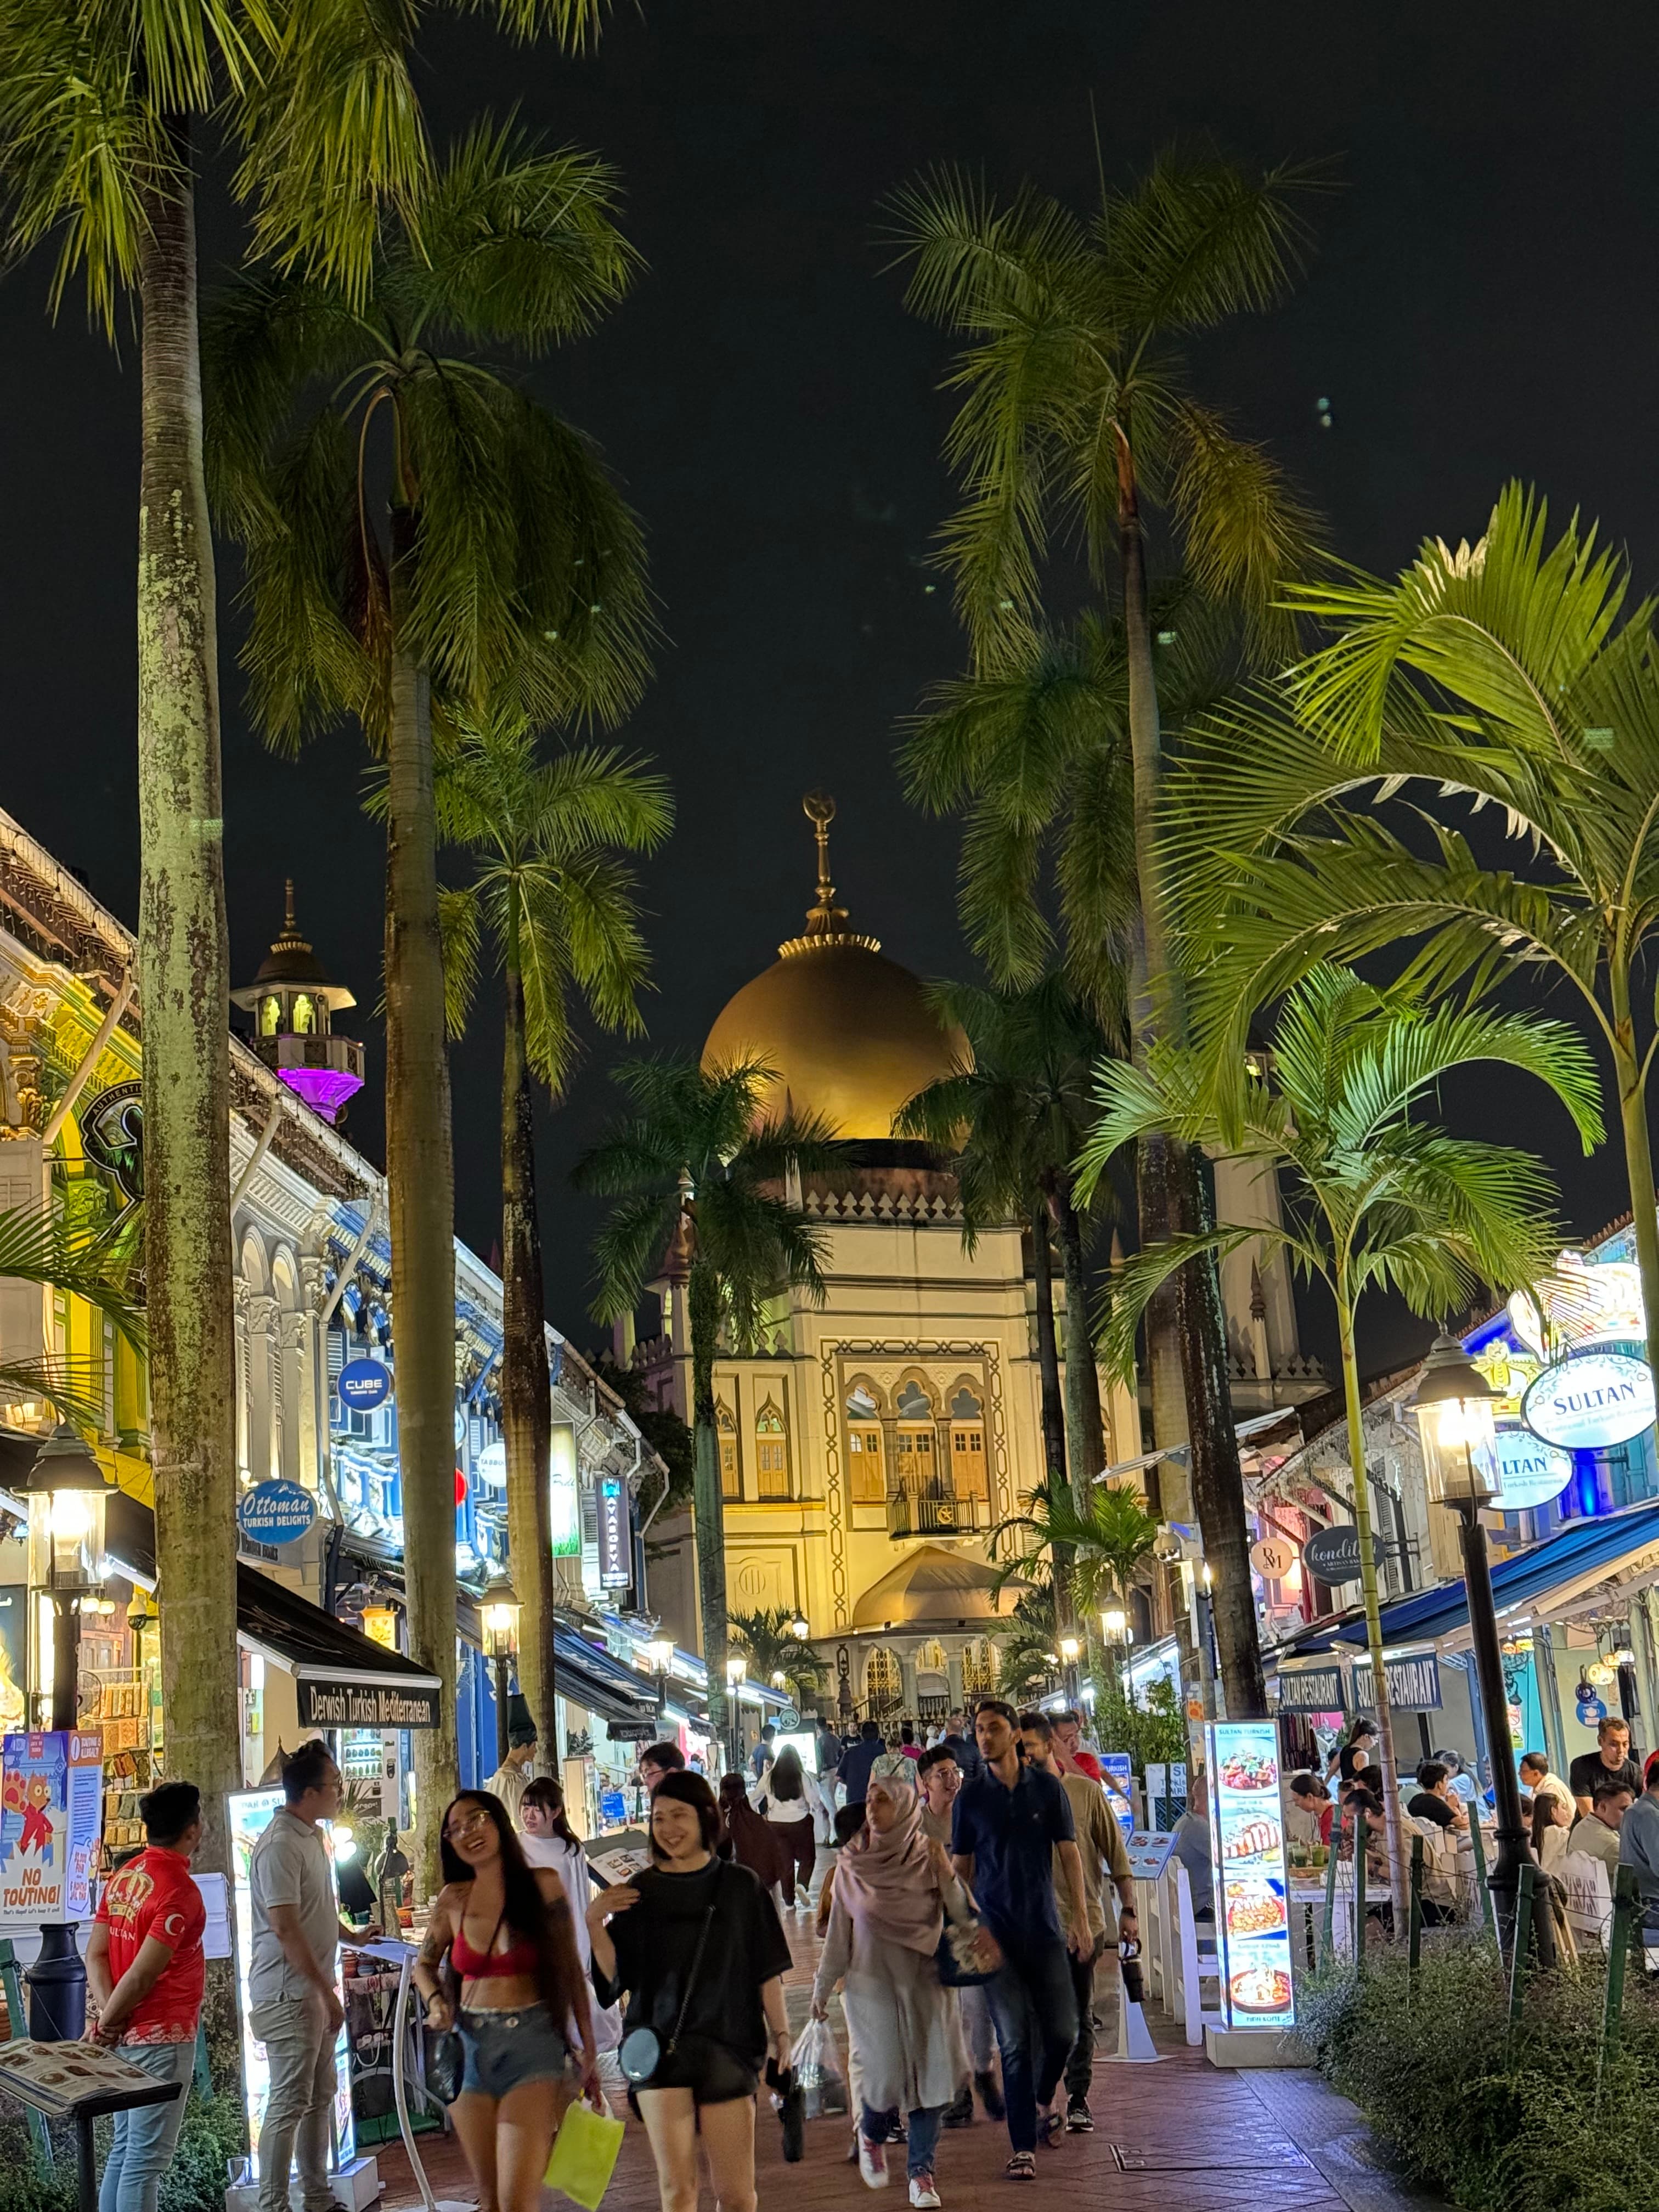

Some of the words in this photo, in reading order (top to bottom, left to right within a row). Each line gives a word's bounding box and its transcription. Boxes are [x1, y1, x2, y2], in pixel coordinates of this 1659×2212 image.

[346, 1379, 382, 1390] CUBE
[1553, 1382, 1636, 1415] SULTAN
[1502, 1457, 1548, 1475] LTAN
[244, 1493, 310, 1516] Ottoman
[243, 1516, 274, 1528] TURKISH
[276, 1514, 311, 1527] DELIGHTS
[607, 1497, 619, 1572] AYASOFYA
[1282, 1675, 1301, 1707] SULTAN
[1301, 1672, 1339, 1706] RESTAURANT
[1356, 1669, 1376, 1708] SULT
[1384, 1660, 1437, 1706] RESTAURANT
[347, 1688, 377, 1722] Turkish
[378, 1690, 430, 1723] Mediterranean
[1105, 1764, 1127, 1773] URKISH
[22, 1867, 41, 1886] NO
[3, 1884, 61, 1908] TOUTING!
[110, 1926, 136, 1942] ULTAN
